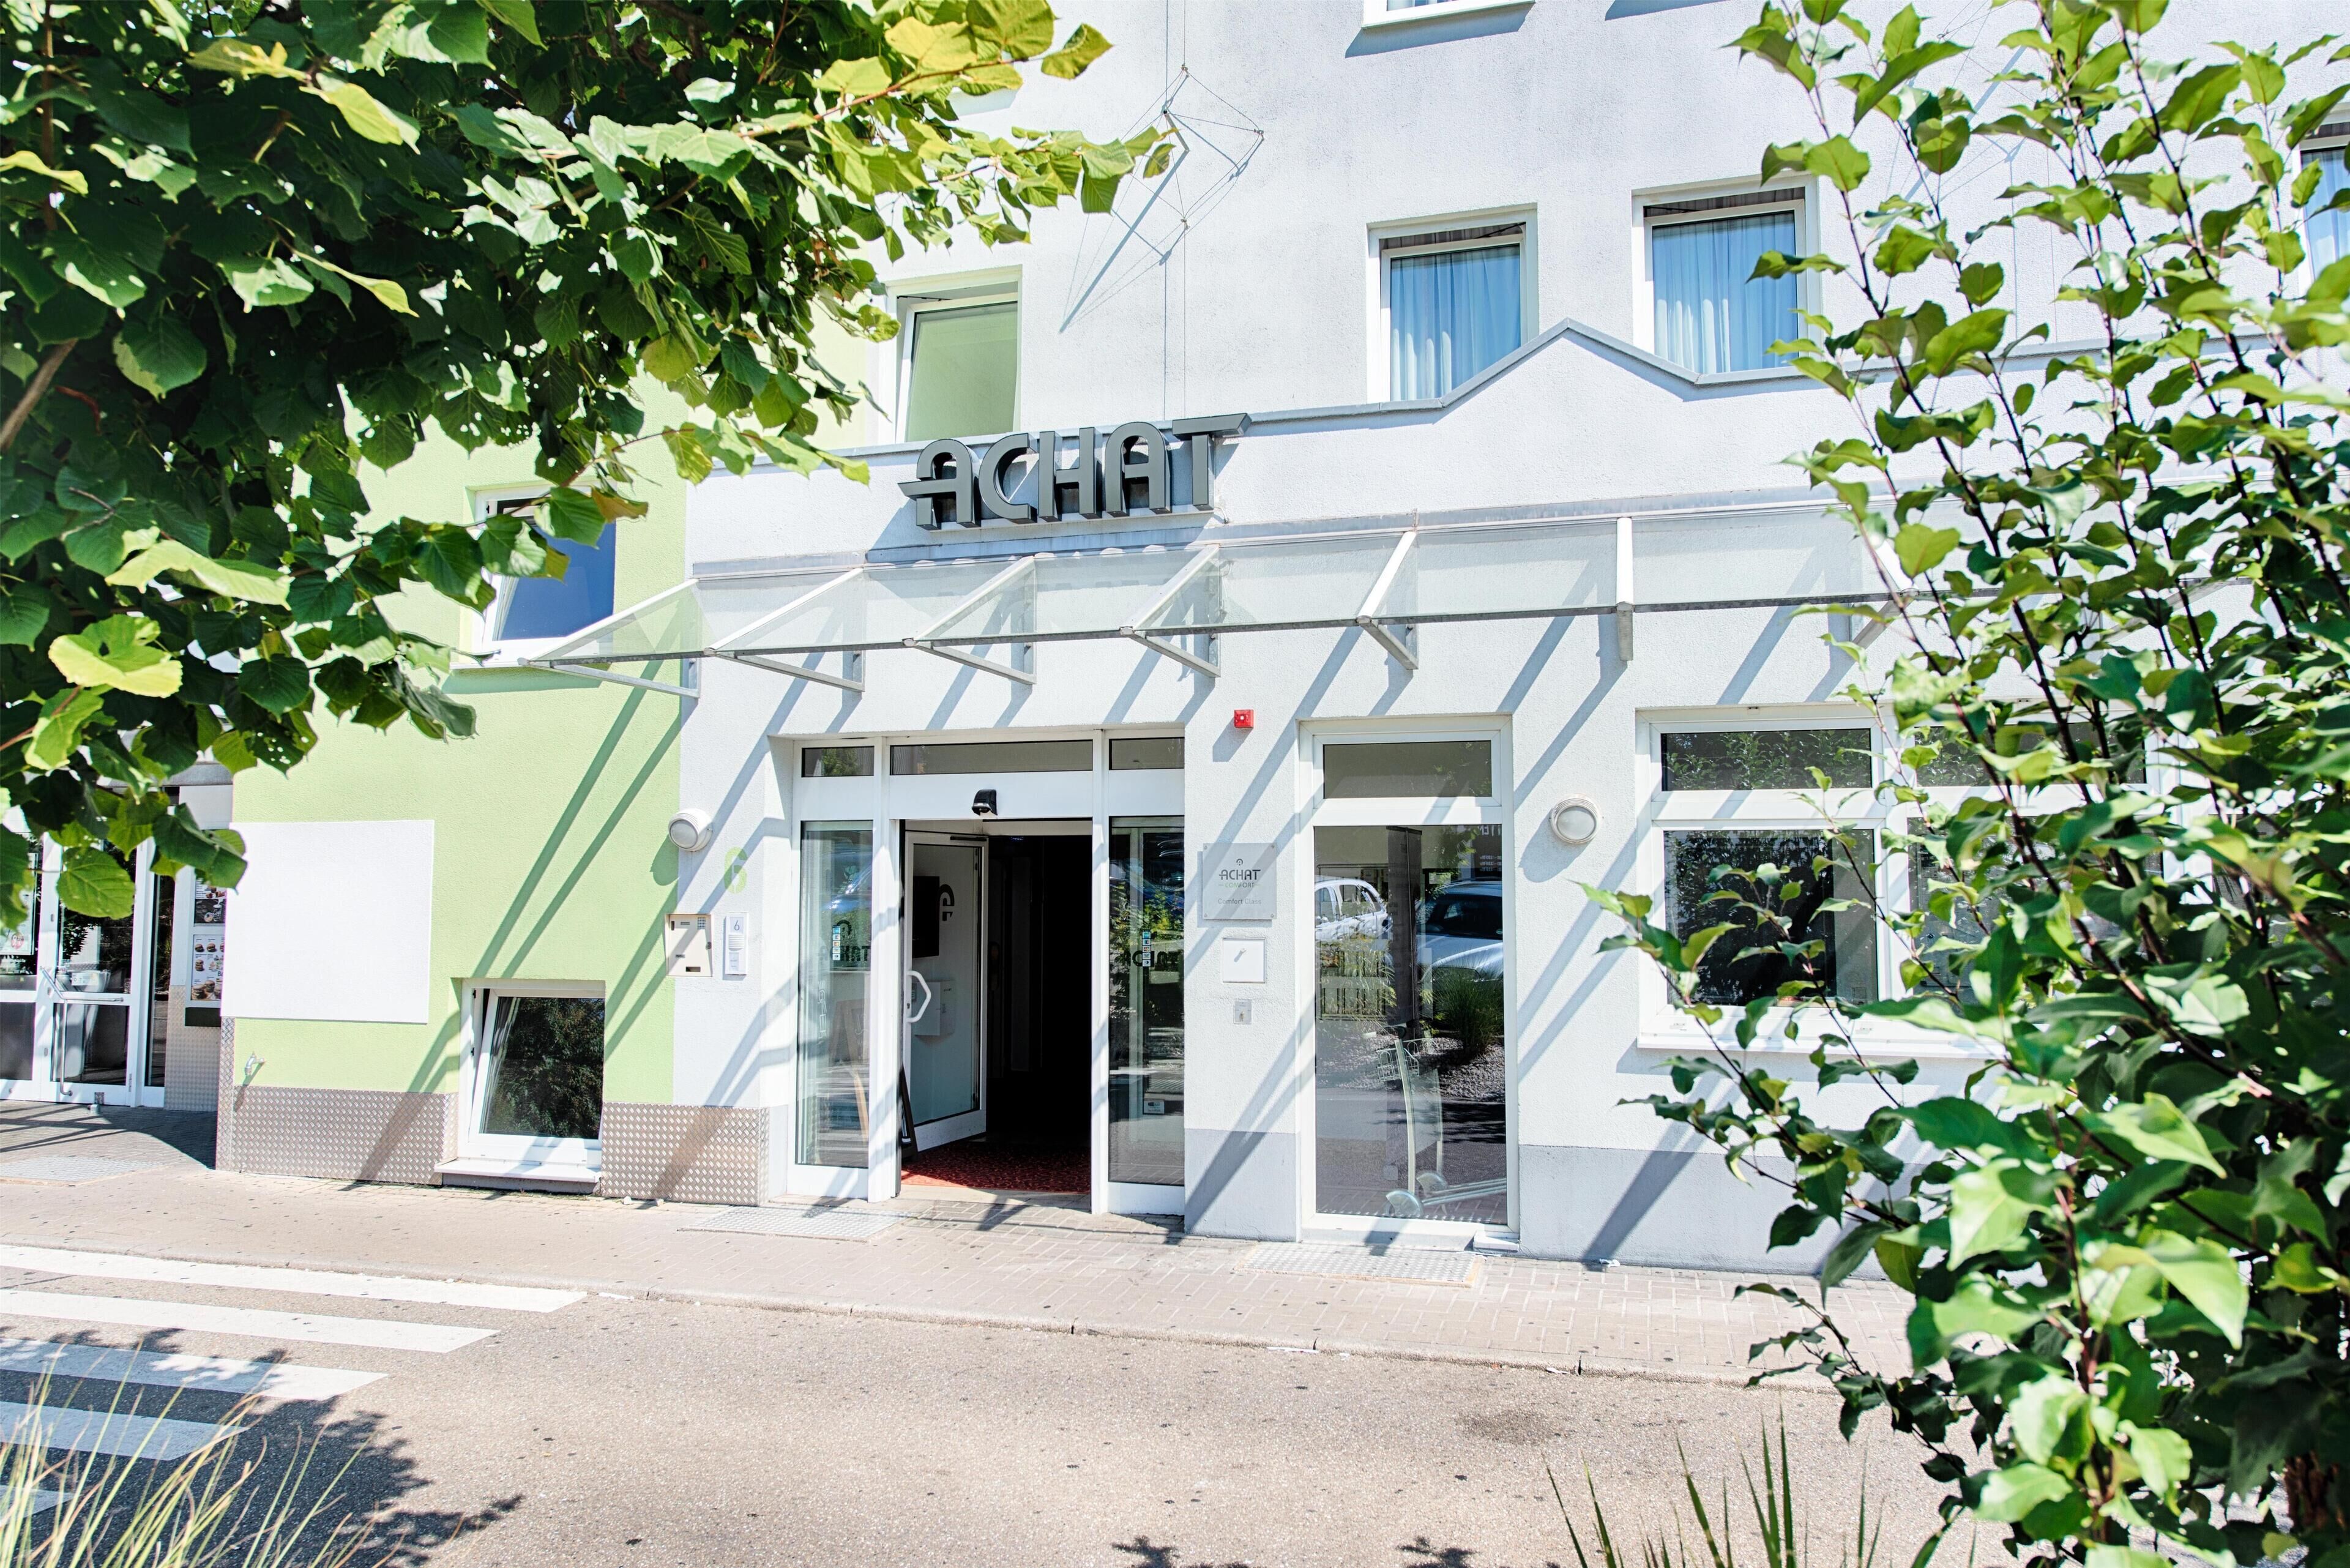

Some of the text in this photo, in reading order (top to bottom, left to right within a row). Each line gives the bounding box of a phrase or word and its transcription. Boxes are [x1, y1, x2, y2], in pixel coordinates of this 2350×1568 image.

[897, 413, 1251, 529] ACHAT
[725, 847, 748, 894] 6
[1219, 869, 1261, 880] ACHAT
[734, 920, 740, 931] 6
